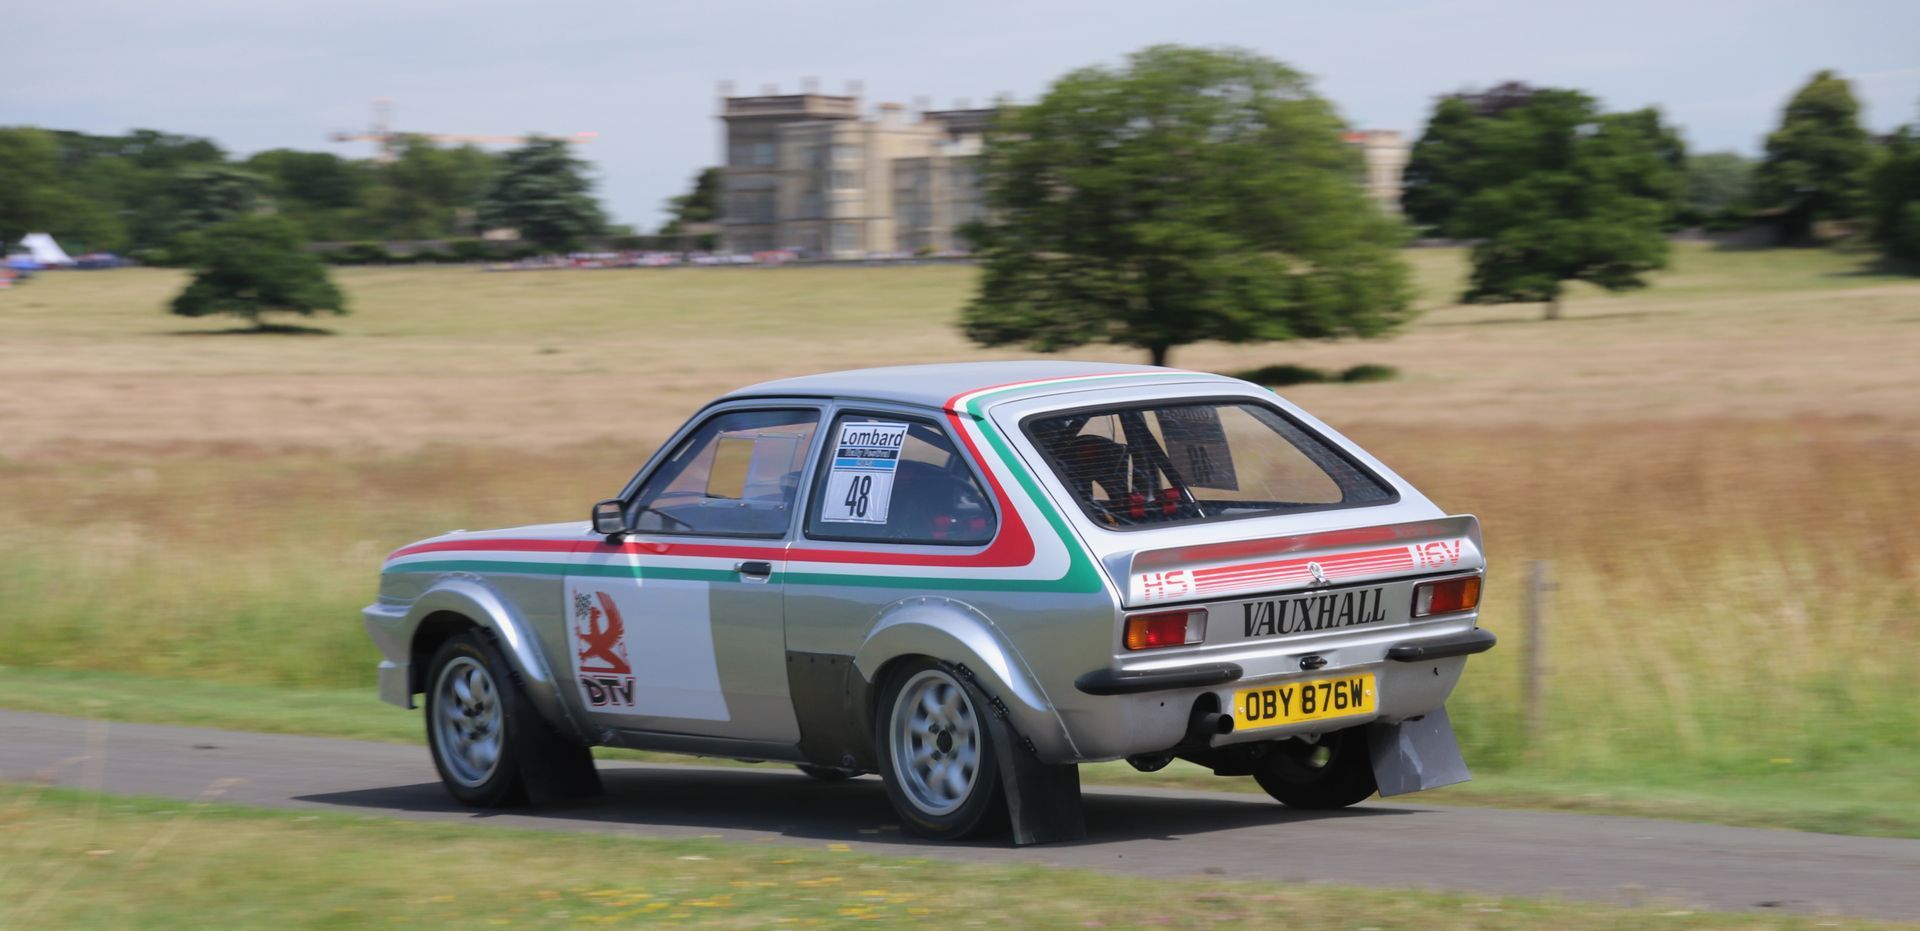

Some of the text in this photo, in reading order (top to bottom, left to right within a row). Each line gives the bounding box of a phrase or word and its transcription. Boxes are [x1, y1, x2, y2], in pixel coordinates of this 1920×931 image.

[840, 428, 905, 447] Lombard
[844, 475, 872, 518] 48
[1142, 540, 1461, 601] HS 16V
[1243, 587, 1386, 638] VAUXHALL
[580, 674, 636, 707] DTV
[1245, 678, 1363, 722] OBY 876W
